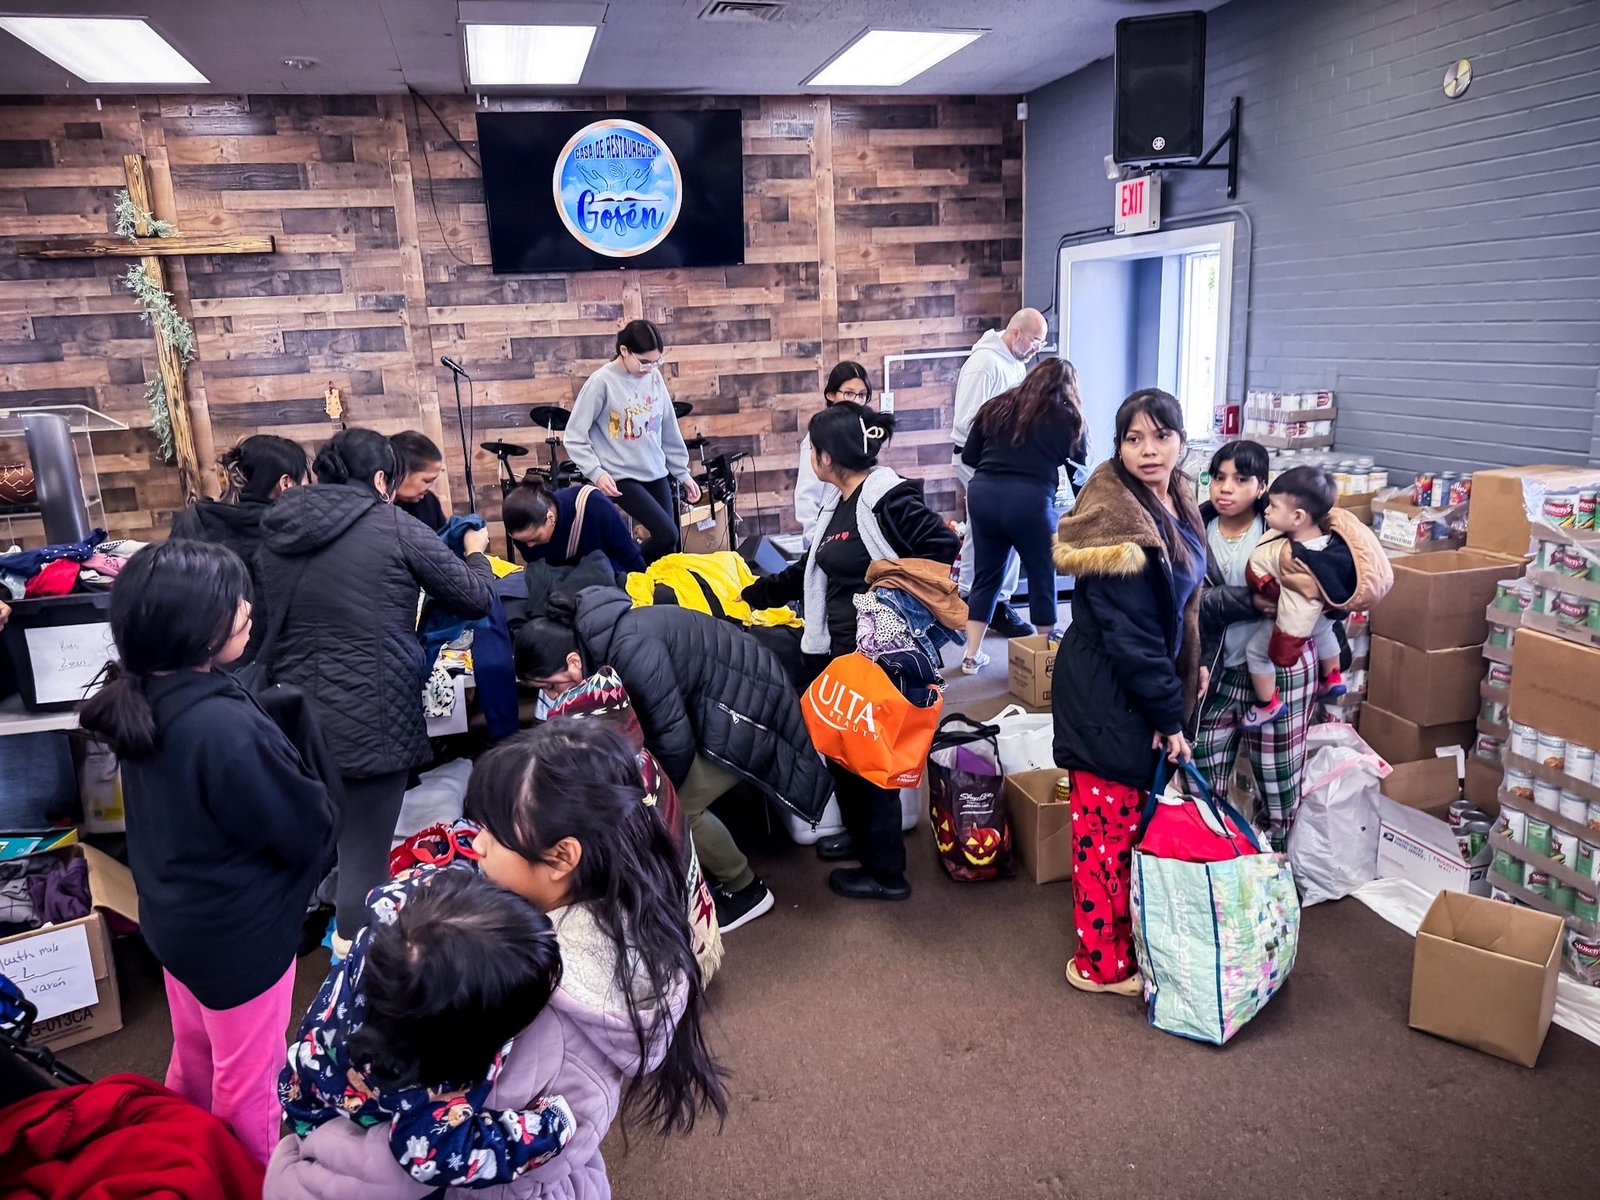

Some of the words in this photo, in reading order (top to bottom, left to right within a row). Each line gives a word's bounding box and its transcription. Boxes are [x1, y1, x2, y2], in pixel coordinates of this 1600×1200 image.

[575, 144, 594, 159] CASA
[595, 139, 605, 159] DE
[605, 133, 658, 159] RESTAURACIÓN
[577, 189, 664, 237] Gosén
[1122, 181, 1145, 217] EXIT
[818, 673, 876, 734] ULTA
[828, 710, 880, 742] BEAUTY
[1433, 856, 1459, 873] PRIORITY
[1438, 864, 1452, 874] MAIL
